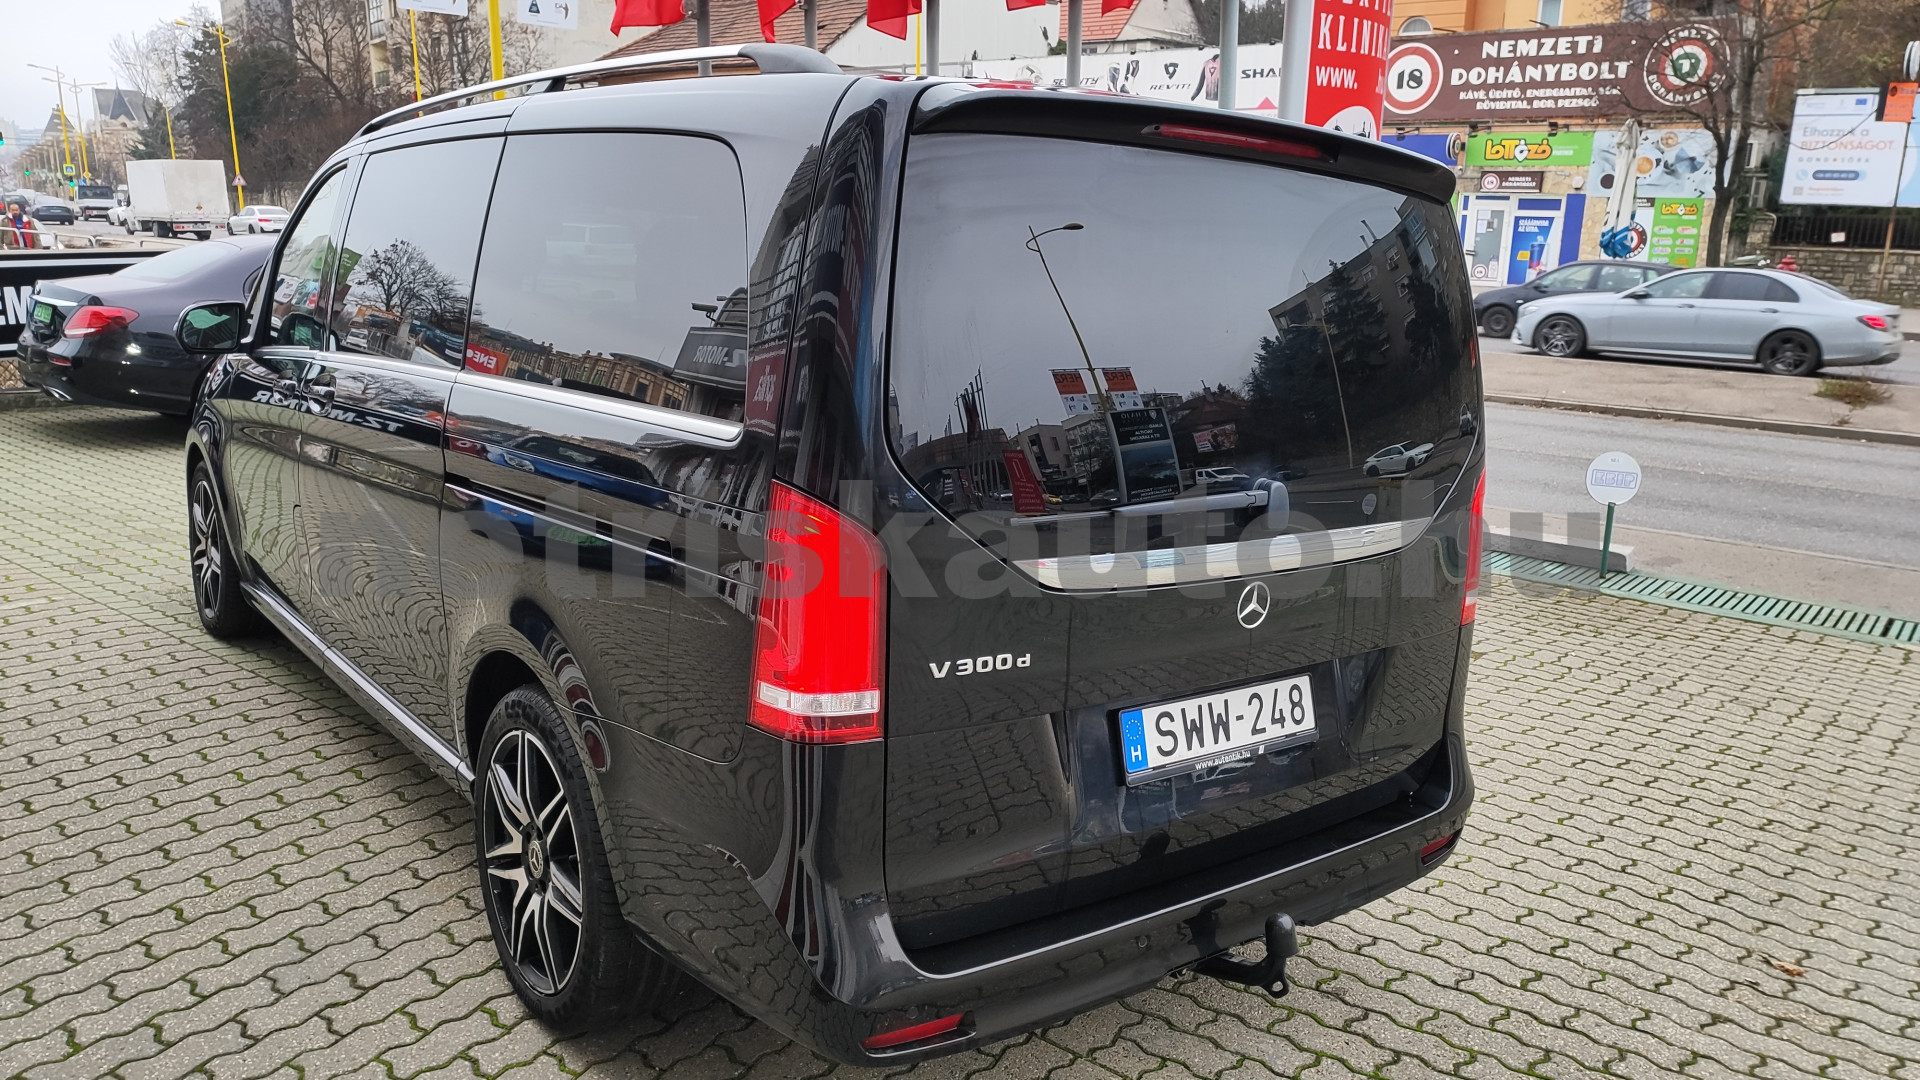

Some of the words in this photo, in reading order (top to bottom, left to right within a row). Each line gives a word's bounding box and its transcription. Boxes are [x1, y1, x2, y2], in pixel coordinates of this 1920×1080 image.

[1481, 35, 1603, 59] NEMZETI
[1241, 69, 1281, 79] SHA
[1397, 68, 1423, 90] 18
[1450, 60, 1631, 86] DOHÁNYBOLT
[1149, 83, 1191, 91] REV'IT!
[1155, 684, 1306, 758] SWW-248
[1130, 745, 1143, 763] H
[1194, 749, 1251, 770] www.autentik.hu
